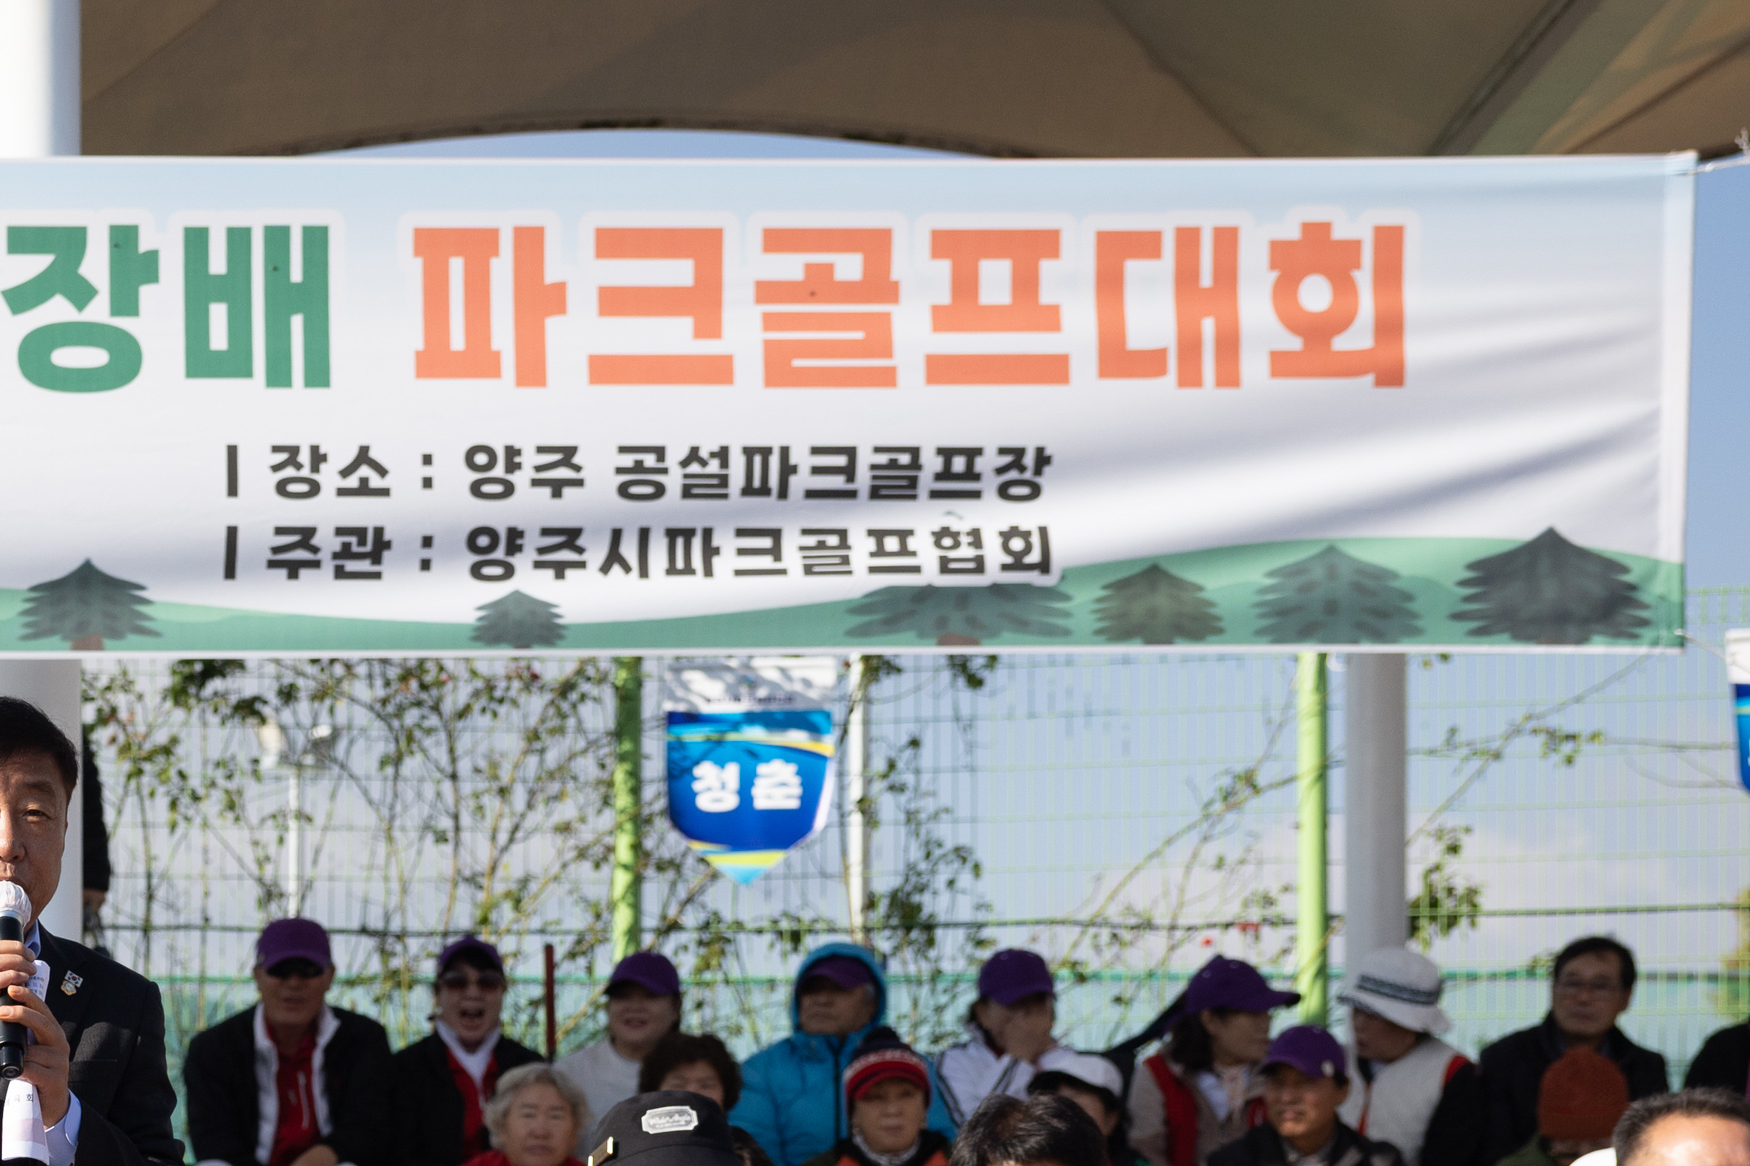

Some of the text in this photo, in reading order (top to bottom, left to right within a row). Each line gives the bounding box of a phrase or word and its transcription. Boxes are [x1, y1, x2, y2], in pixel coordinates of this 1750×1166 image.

[412, 220, 1407, 390] 파크골프대회
[269, 443, 392, 501] 장소
[463, 444, 586, 502] 양주
[614, 444, 1054, 504] 공설파크골프장
[265, 525, 393, 582] 주관
[464, 525, 1053, 583] 양주시파크골프협회
